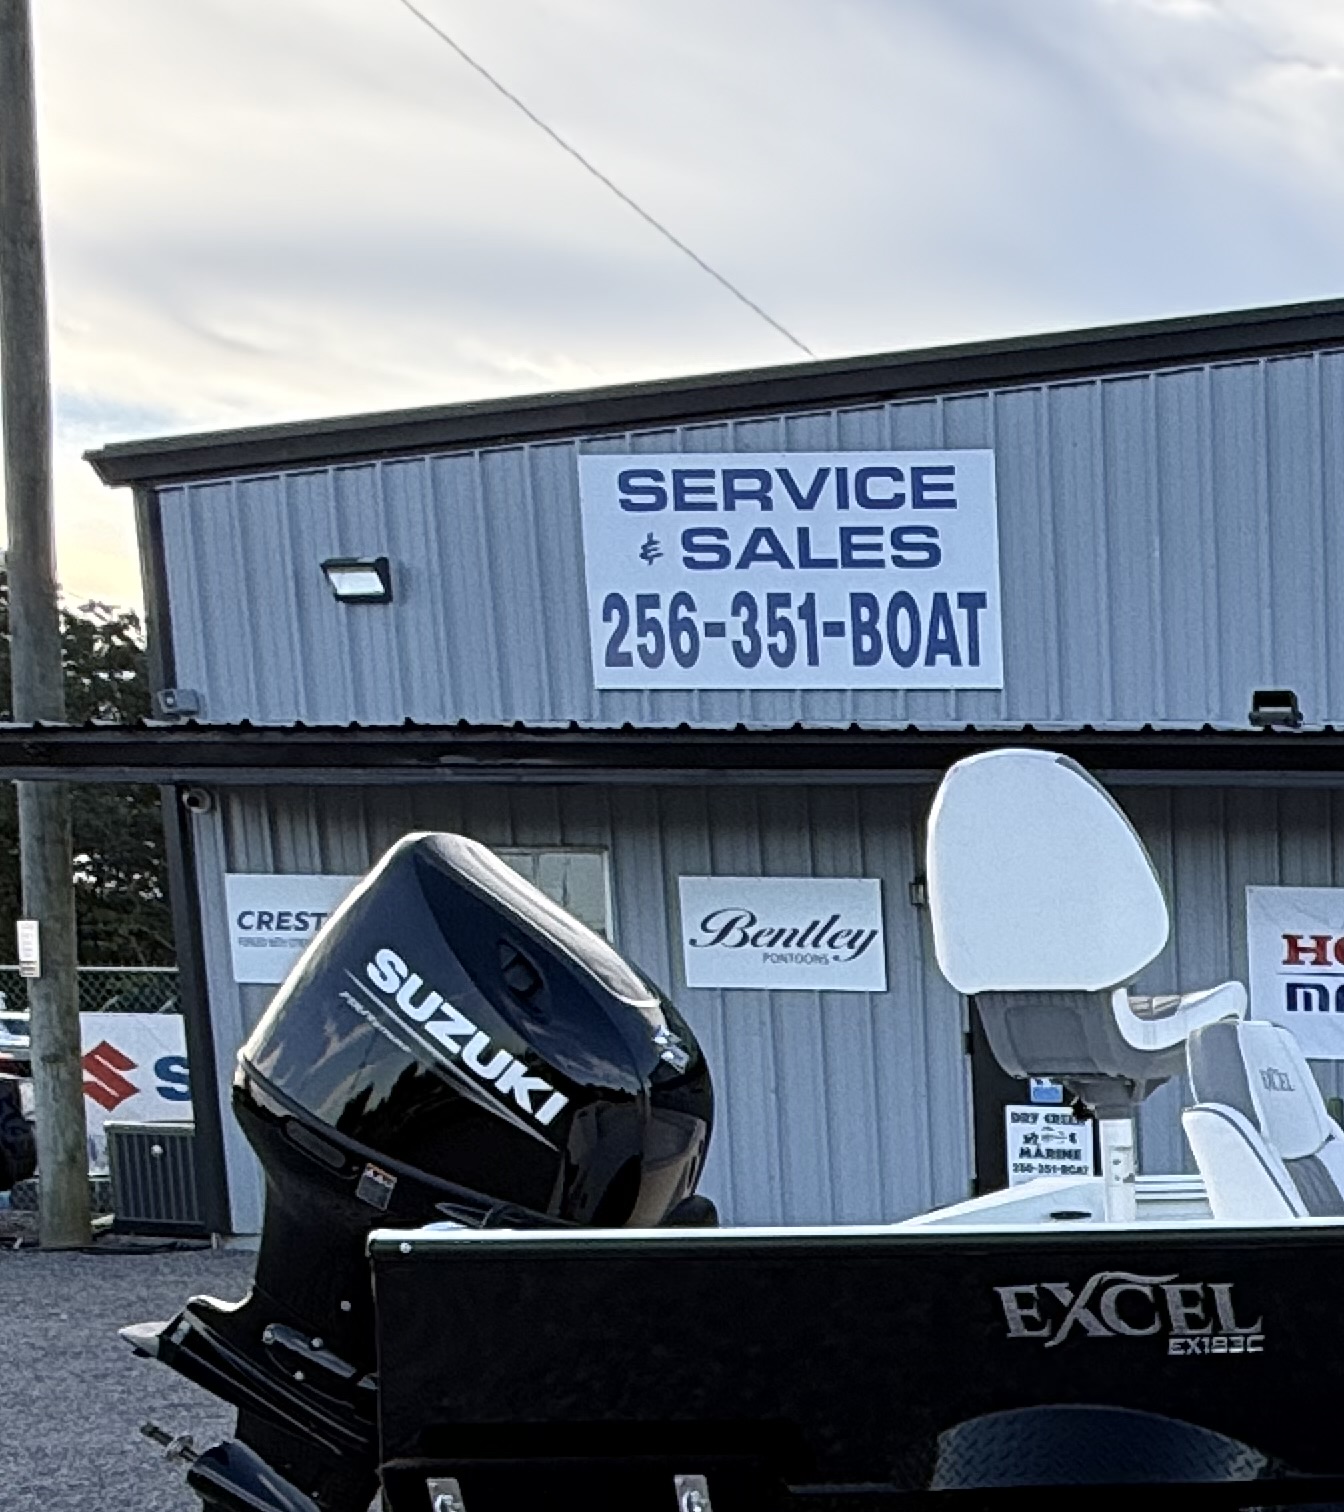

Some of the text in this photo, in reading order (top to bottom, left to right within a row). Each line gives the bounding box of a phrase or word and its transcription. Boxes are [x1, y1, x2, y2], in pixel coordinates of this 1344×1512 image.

[617, 465, 957, 511] SERVICE
[680, 526, 942, 570] SALES
[602, 590, 988, 669] 256-351-BOAT
[689, 907, 879, 962] Bentley
[762, 952, 830, 965] PONTOONS
[366, 948, 570, 1126] SUZUKI
[993, 1271, 1264, 1348] EXCEL
